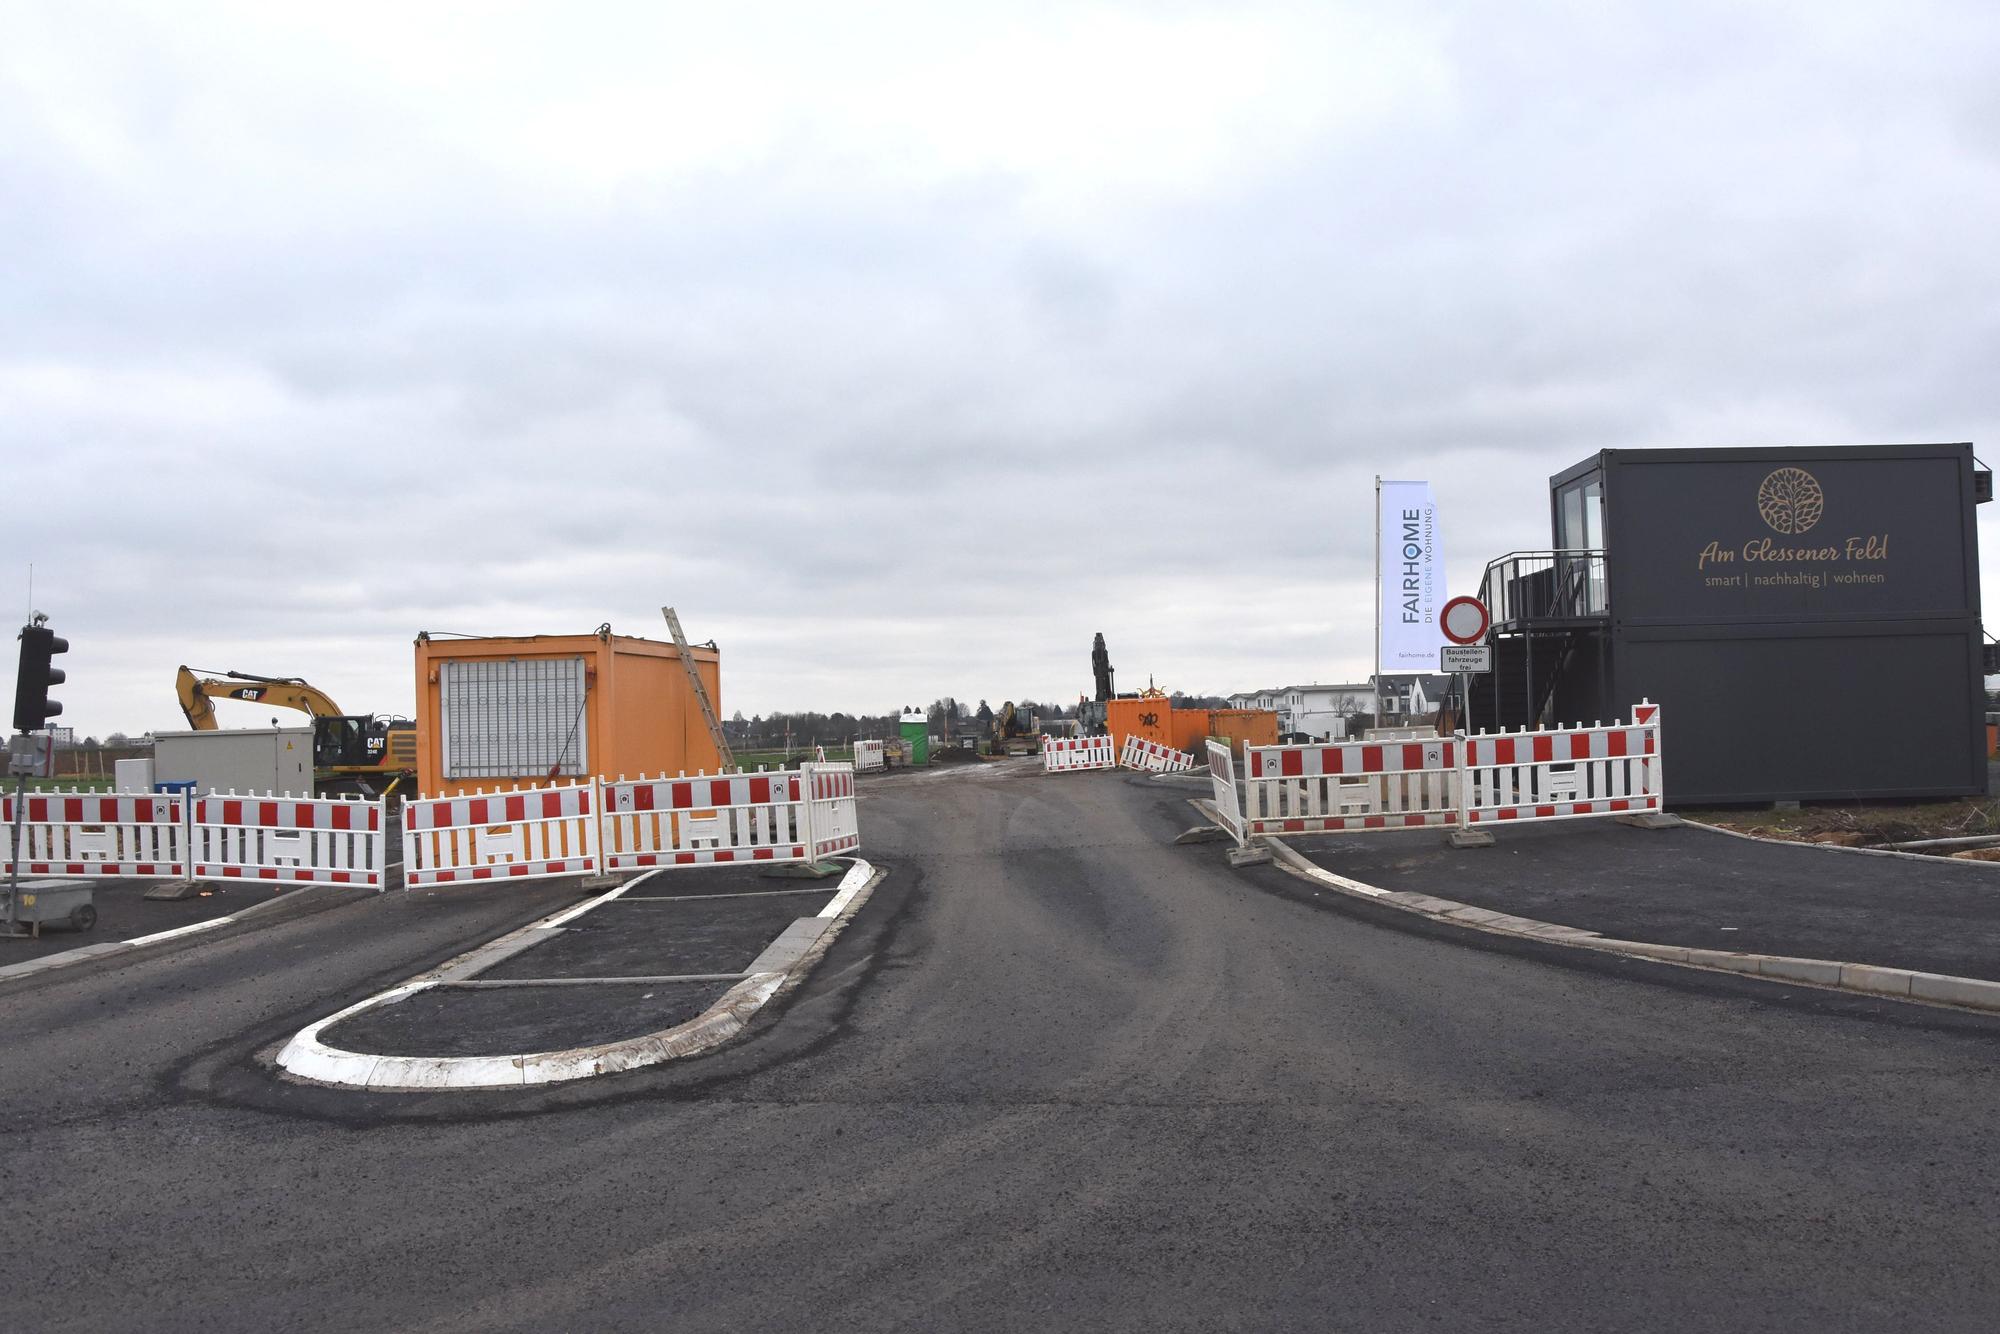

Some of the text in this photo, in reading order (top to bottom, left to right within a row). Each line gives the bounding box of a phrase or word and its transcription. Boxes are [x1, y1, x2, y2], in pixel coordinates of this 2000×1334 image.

[1698, 534, 1889, 570] Am Glessener Feld
[1403, 509, 1421, 623] FAIRHOME
[1705, 570, 1885, 588] smart nachhaltig wohnen
[242, 688, 259, 700] CAT
[367, 737, 385, 748] CAT
